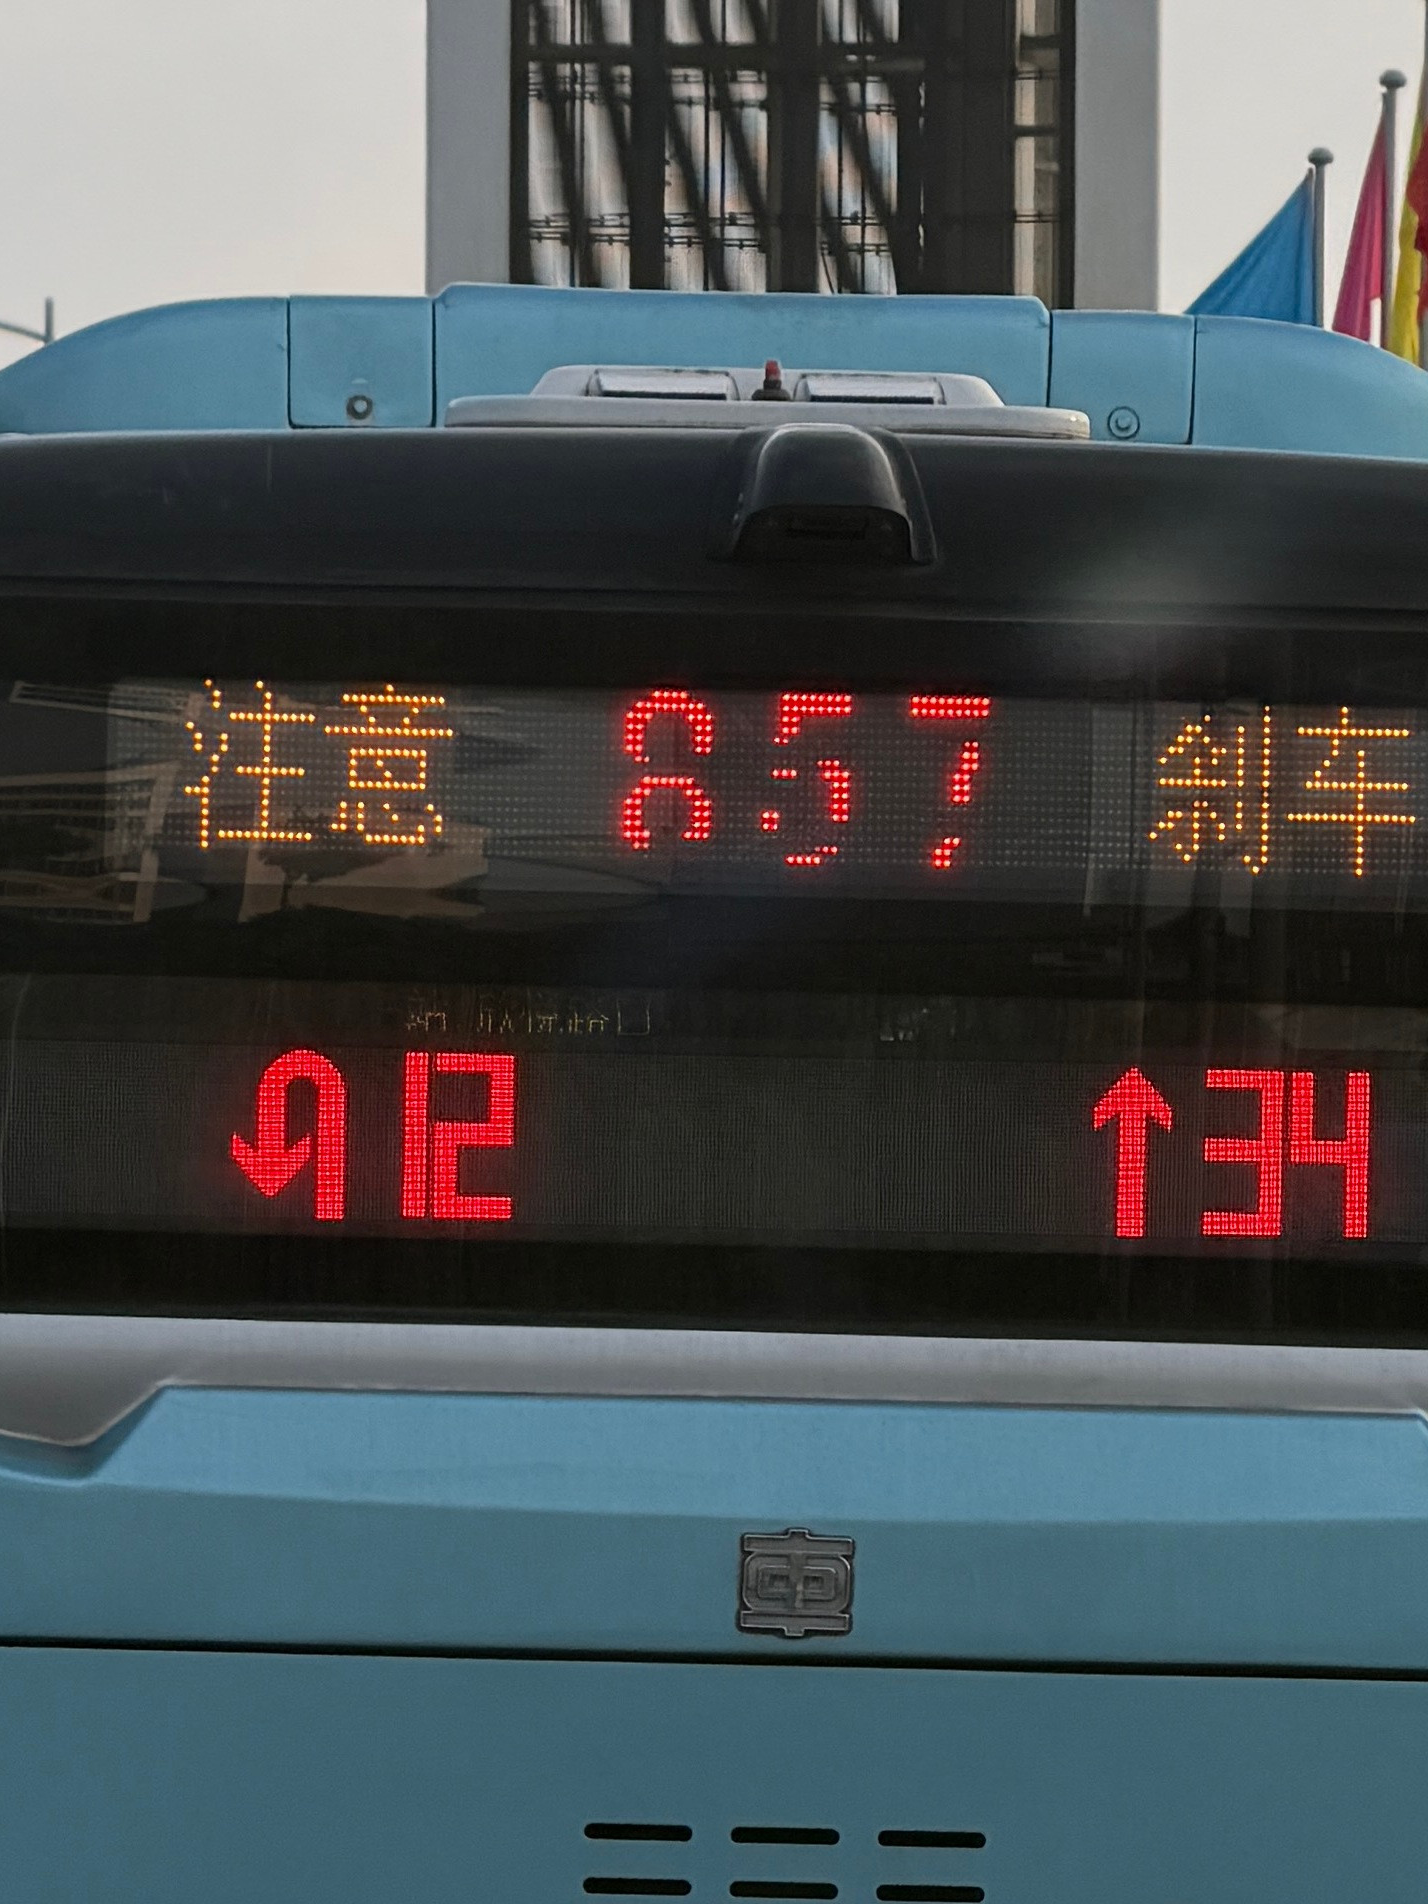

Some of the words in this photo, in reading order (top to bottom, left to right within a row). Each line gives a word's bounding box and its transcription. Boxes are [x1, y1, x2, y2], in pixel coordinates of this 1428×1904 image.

[182, 678, 454, 851] 注意
[1145, 704, 1417, 879] 刹车
[399, 1050, 517, 1222] 12
[1200, 1068, 1372, 1239] 34
